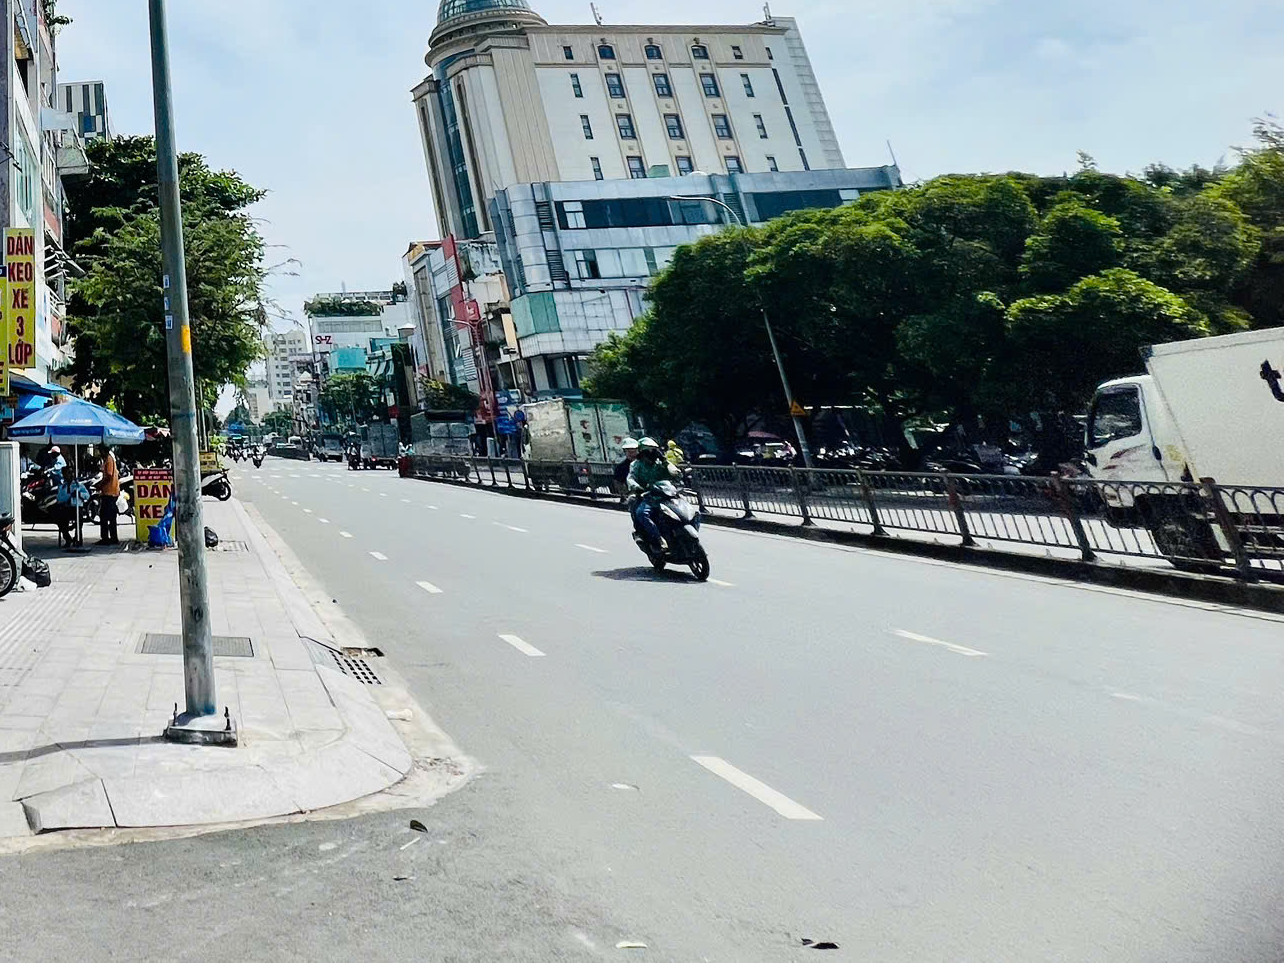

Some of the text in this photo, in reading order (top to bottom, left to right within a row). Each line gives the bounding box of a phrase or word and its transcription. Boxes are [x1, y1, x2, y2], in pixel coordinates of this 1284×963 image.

[7, 231, 34, 257] DÁN
[7, 261, 34, 283] KEO
[12, 287, 29, 310] XE
[15, 315, 25, 337] 3
[137, 481, 174, 498] DÁN
[139, 504, 164, 519] KE
